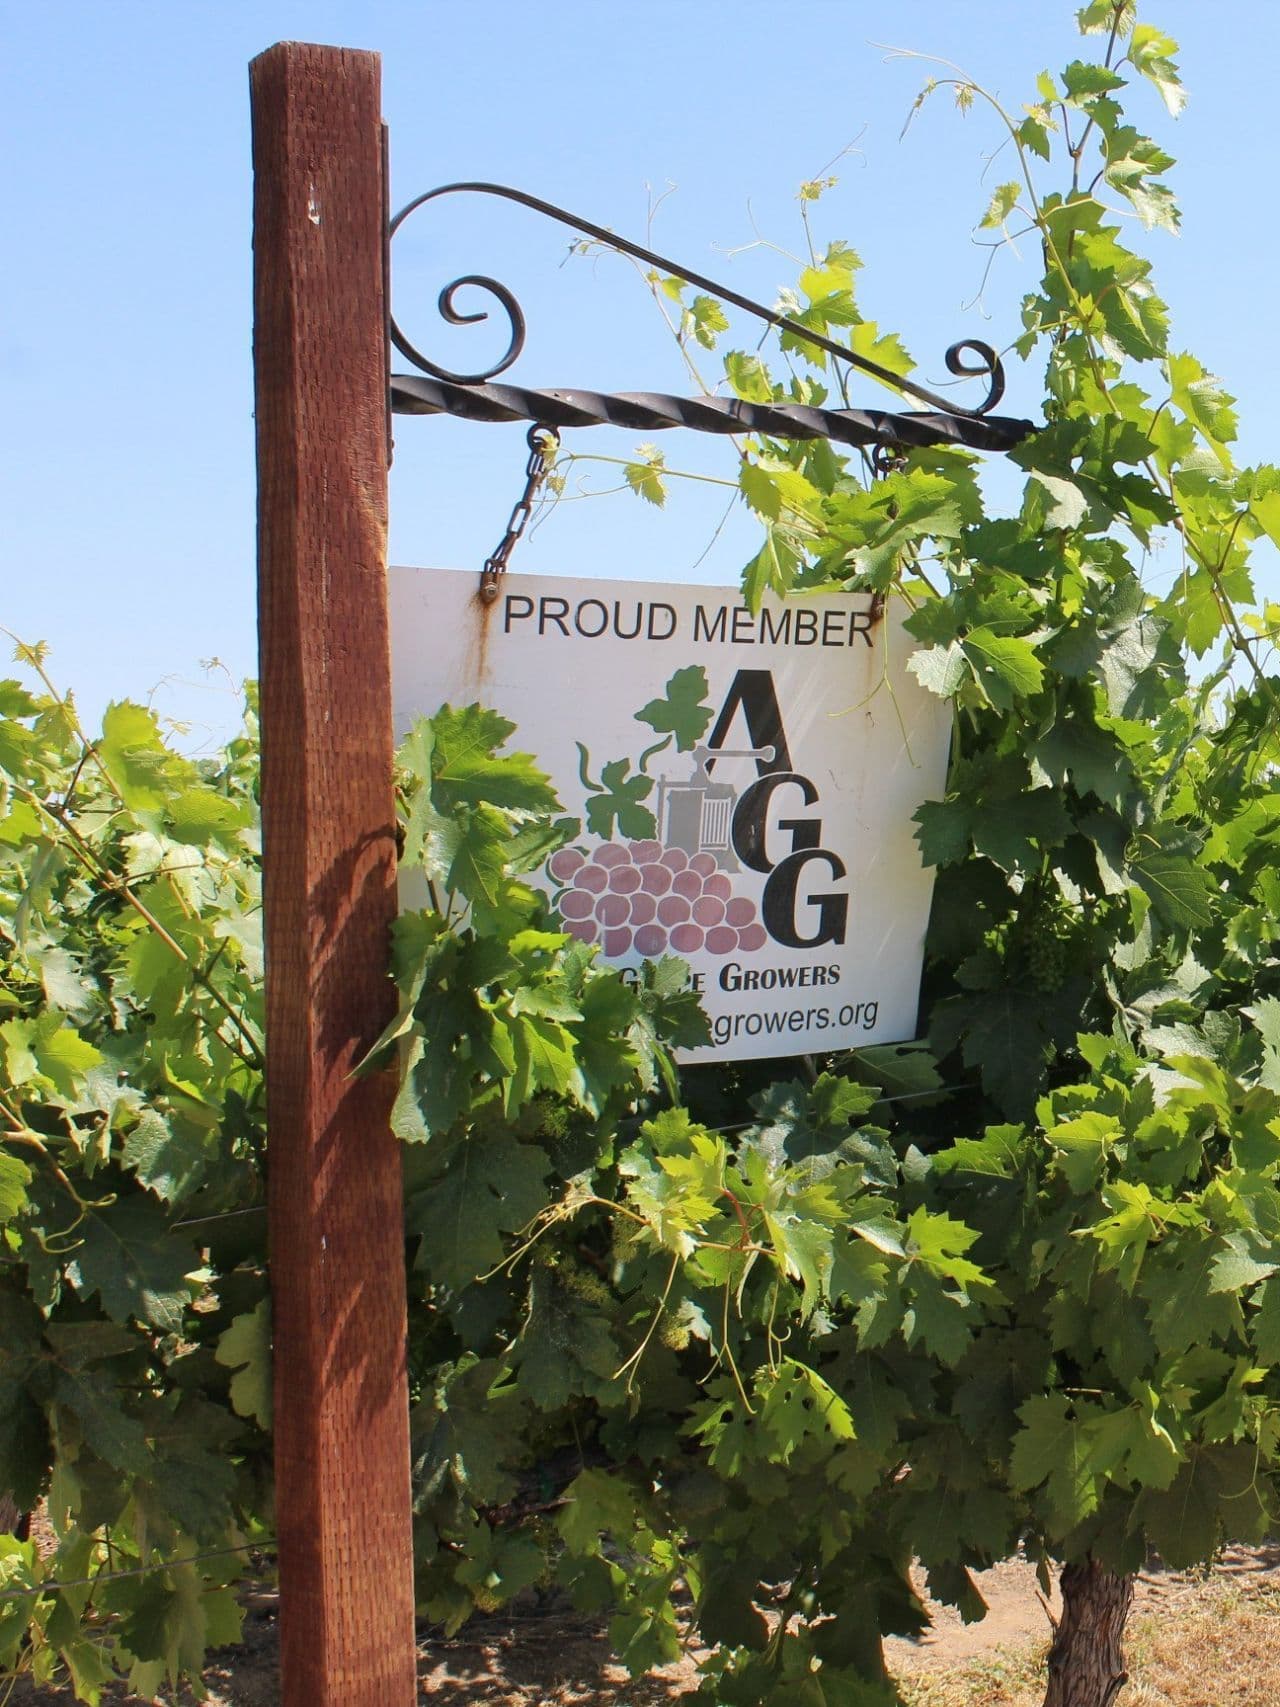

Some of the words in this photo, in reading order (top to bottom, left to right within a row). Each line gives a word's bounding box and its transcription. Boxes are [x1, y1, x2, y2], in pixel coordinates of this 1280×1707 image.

[504, 594, 678, 641] PROUD
[693, 605, 875, 648] MEMBER
[719, 962, 841, 992] GROWERS
[705, 1000, 879, 1045] growers.org
